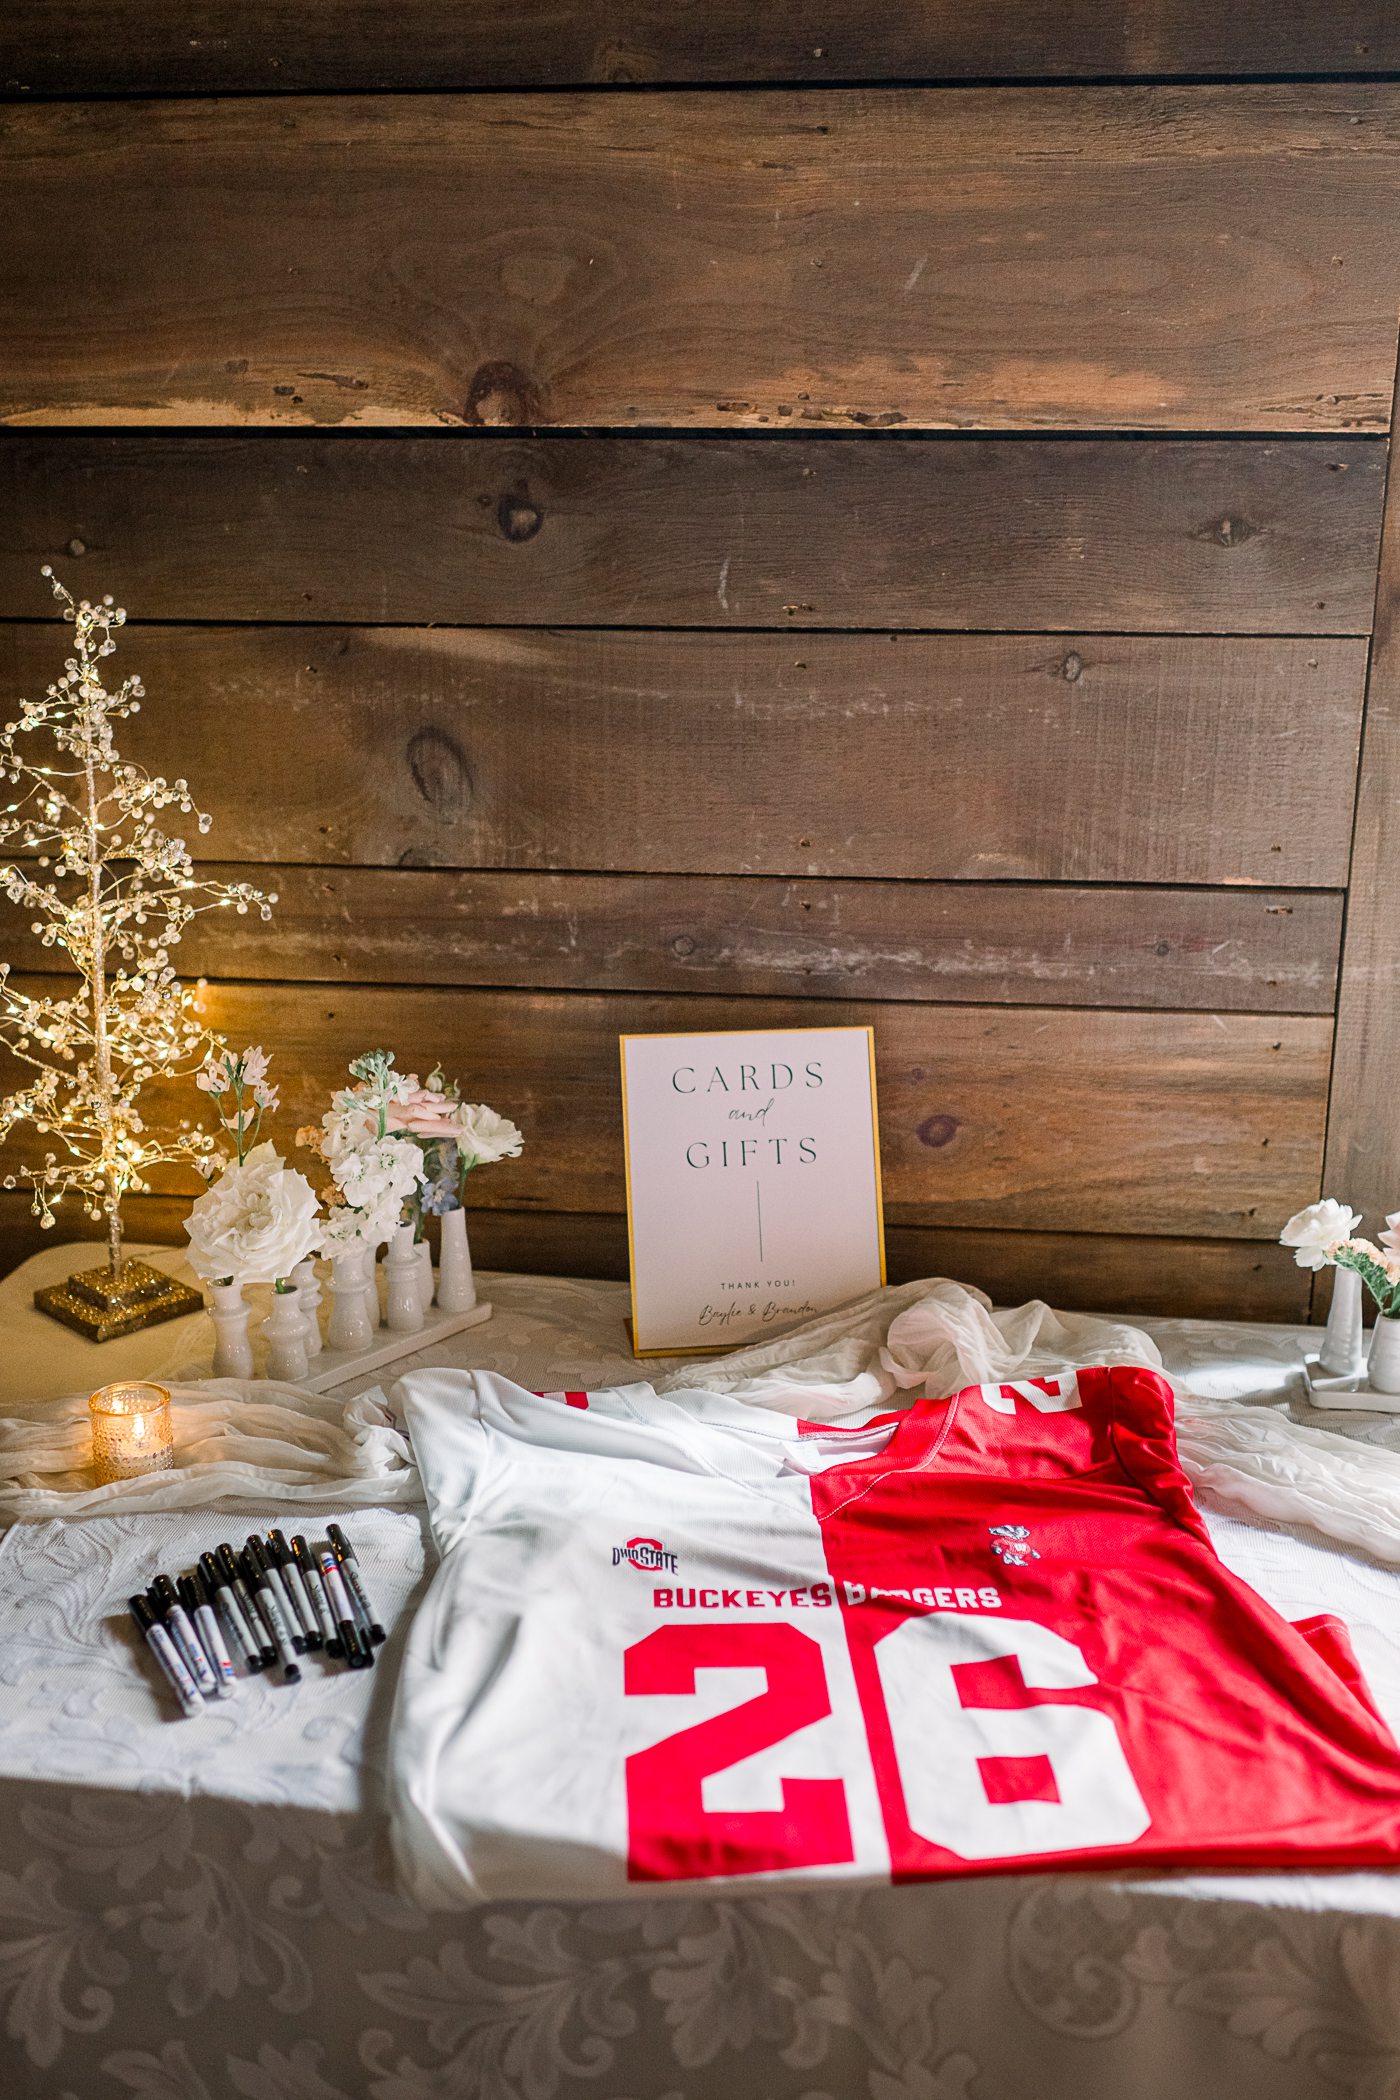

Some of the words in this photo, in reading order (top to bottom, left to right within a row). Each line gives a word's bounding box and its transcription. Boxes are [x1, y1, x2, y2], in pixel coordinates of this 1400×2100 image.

[672, 1061, 823, 1094] CARDS
[728, 1097, 775, 1127] and
[686, 1137, 817, 1169] GIFTS
[720, 1282, 760, 1290] THANK
[766, 1279, 796, 1288] YOU!
[748, 1303, 757, 1316] &
[761, 1300, 818, 1322] Brandon
[639, 1546, 679, 1577] STATE
[653, 1582, 832, 1608] BUCKEYES
